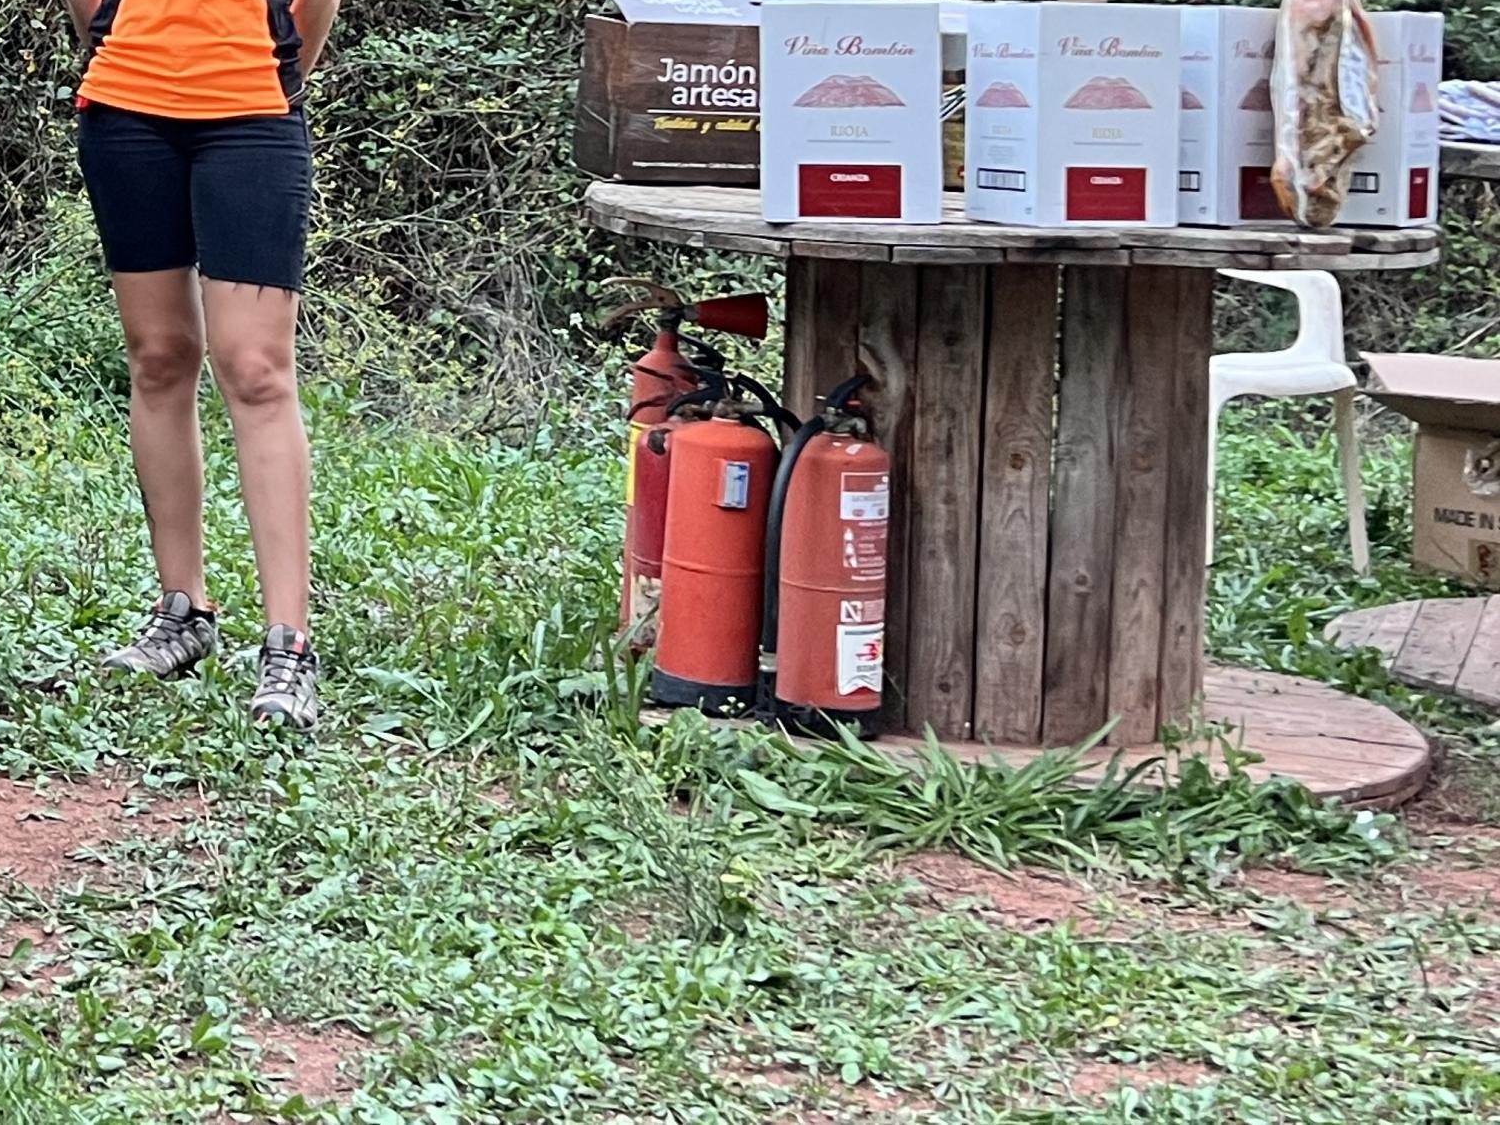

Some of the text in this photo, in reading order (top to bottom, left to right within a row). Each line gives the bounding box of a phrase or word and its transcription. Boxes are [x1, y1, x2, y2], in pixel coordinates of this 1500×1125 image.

[784, 36, 829, 55] Viña
[657, 58, 756, 84] Jamón
[830, 125, 869, 137] RIOJA
[1434, 507, 1476, 527] MADE
[1479, 512, 1495, 530] IN
